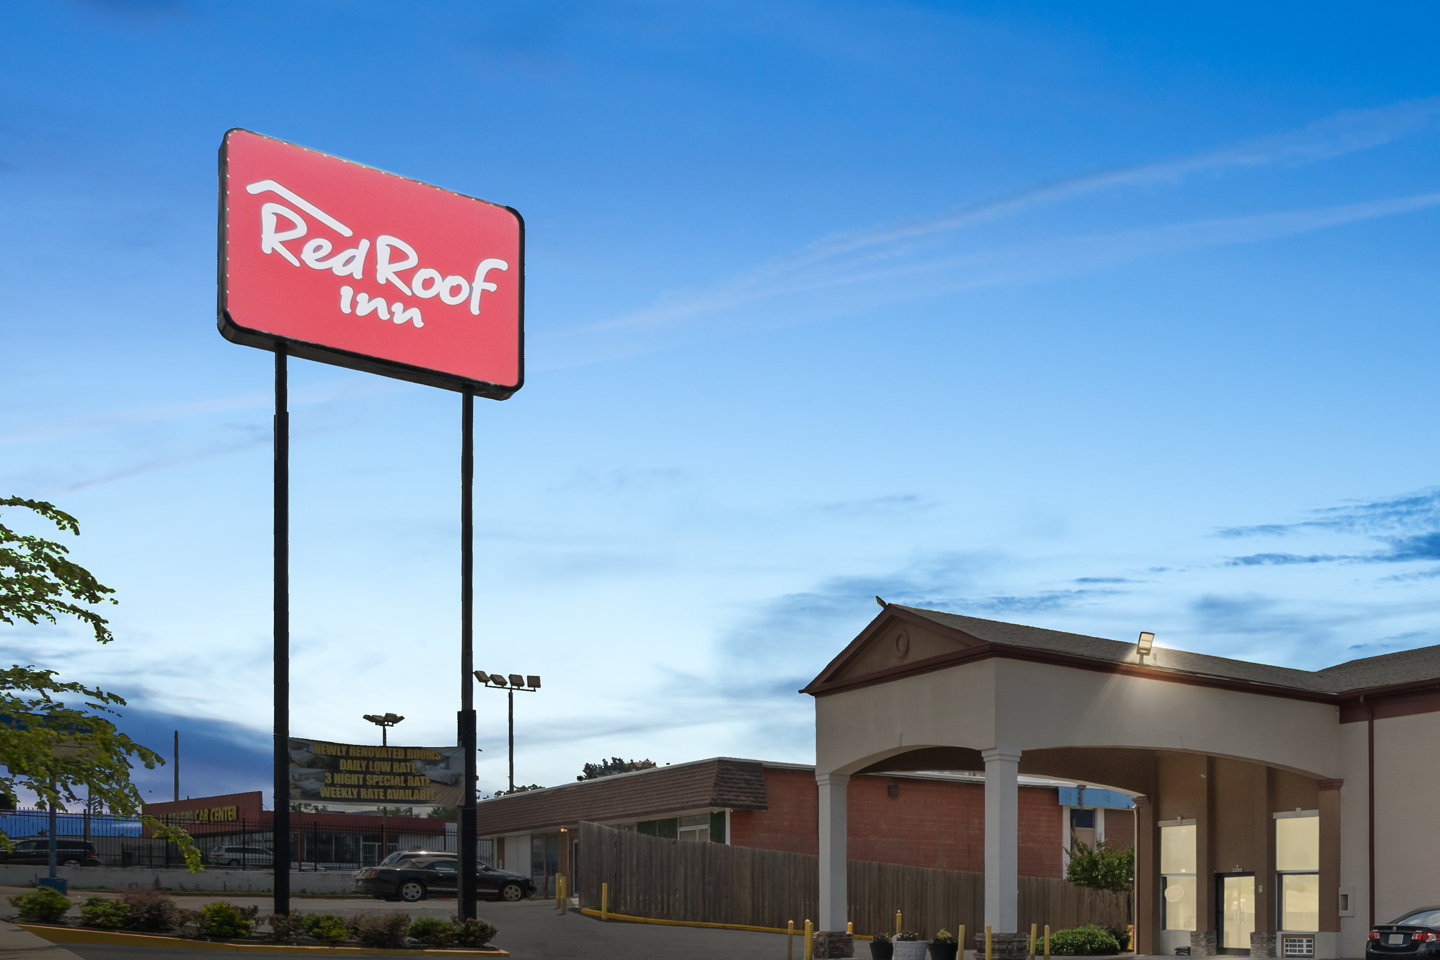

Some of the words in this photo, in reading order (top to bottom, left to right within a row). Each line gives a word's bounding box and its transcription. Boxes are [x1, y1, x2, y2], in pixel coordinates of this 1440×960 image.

[260, 202, 370, 280] Red
[375, 234, 509, 316] Roof
[313, 743, 348, 757] NEWLY
[349, 745, 405, 759] RENOVATED
[407, 748, 441, 760] ROOMS
[339, 759, 367, 771] DAILY
[368, 760, 391, 772] LOW
[393, 761, 417, 774] RATE
[324, 772, 332, 784] 3
[333, 773, 364, 785] NIGHT
[366, 774, 406, 786] SPECIAL
[407, 775, 432, 787] RATE
[319, 787, 358, 799] WEEKLY
[360, 788, 385, 800] RATE
[386, 789, 437, 801] AVAILABLE
[194, 808, 209, 823] CAR
[210, 805, 238, 822] CENTER
